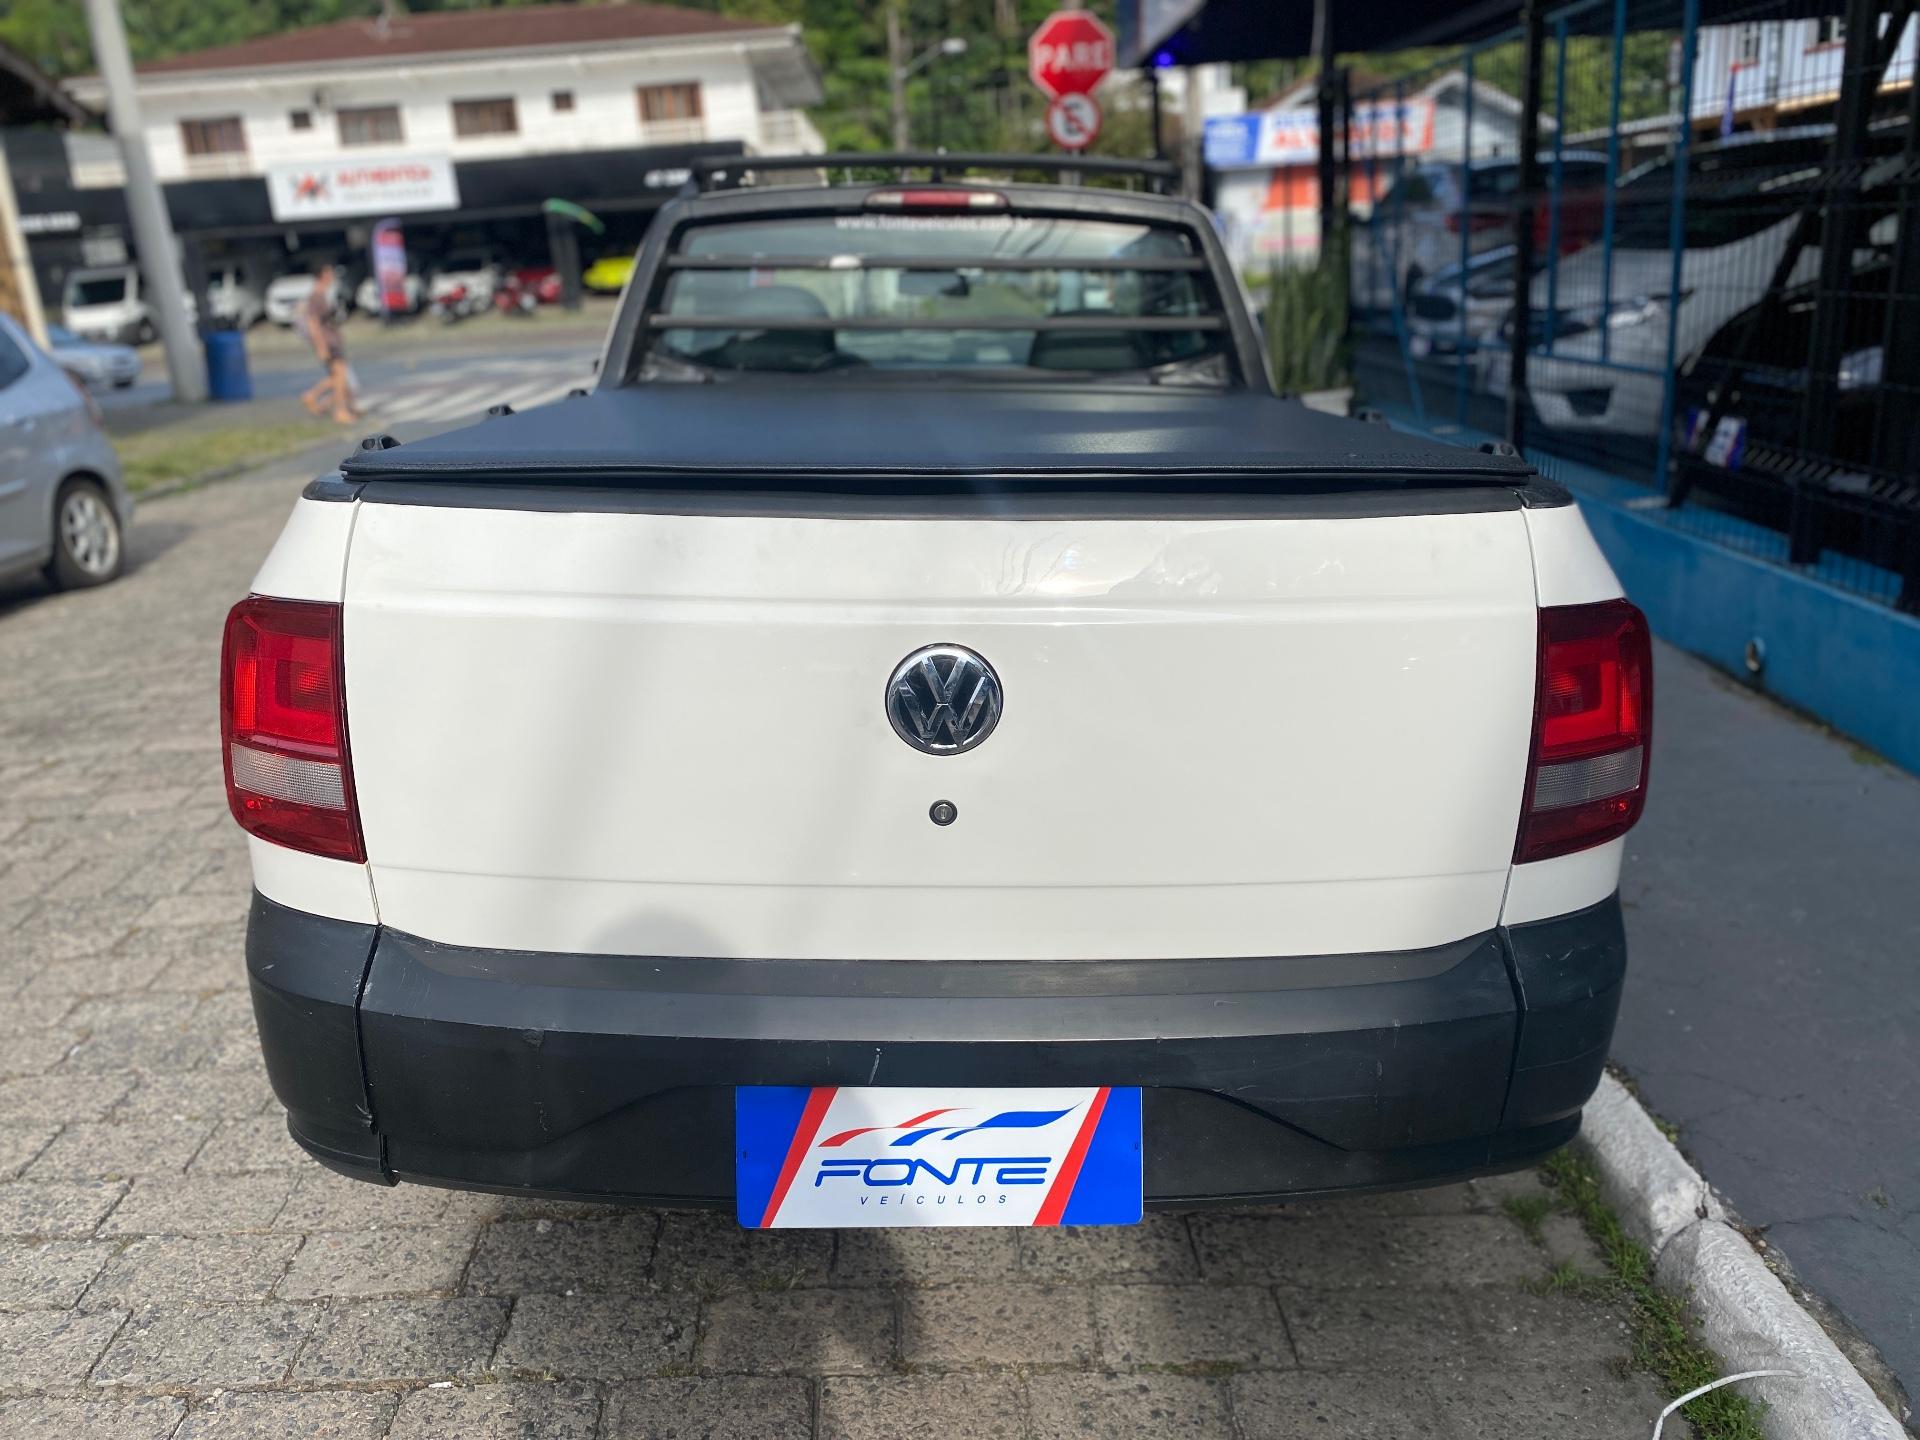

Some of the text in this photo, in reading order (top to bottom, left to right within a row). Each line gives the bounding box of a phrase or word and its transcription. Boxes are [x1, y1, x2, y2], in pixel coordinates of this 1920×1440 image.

[1033, 41, 1112, 73] PARE
[814, 1156, 1052, 1188] FONTE
[860, 1193, 1007, 1206] VEÍCULOS
